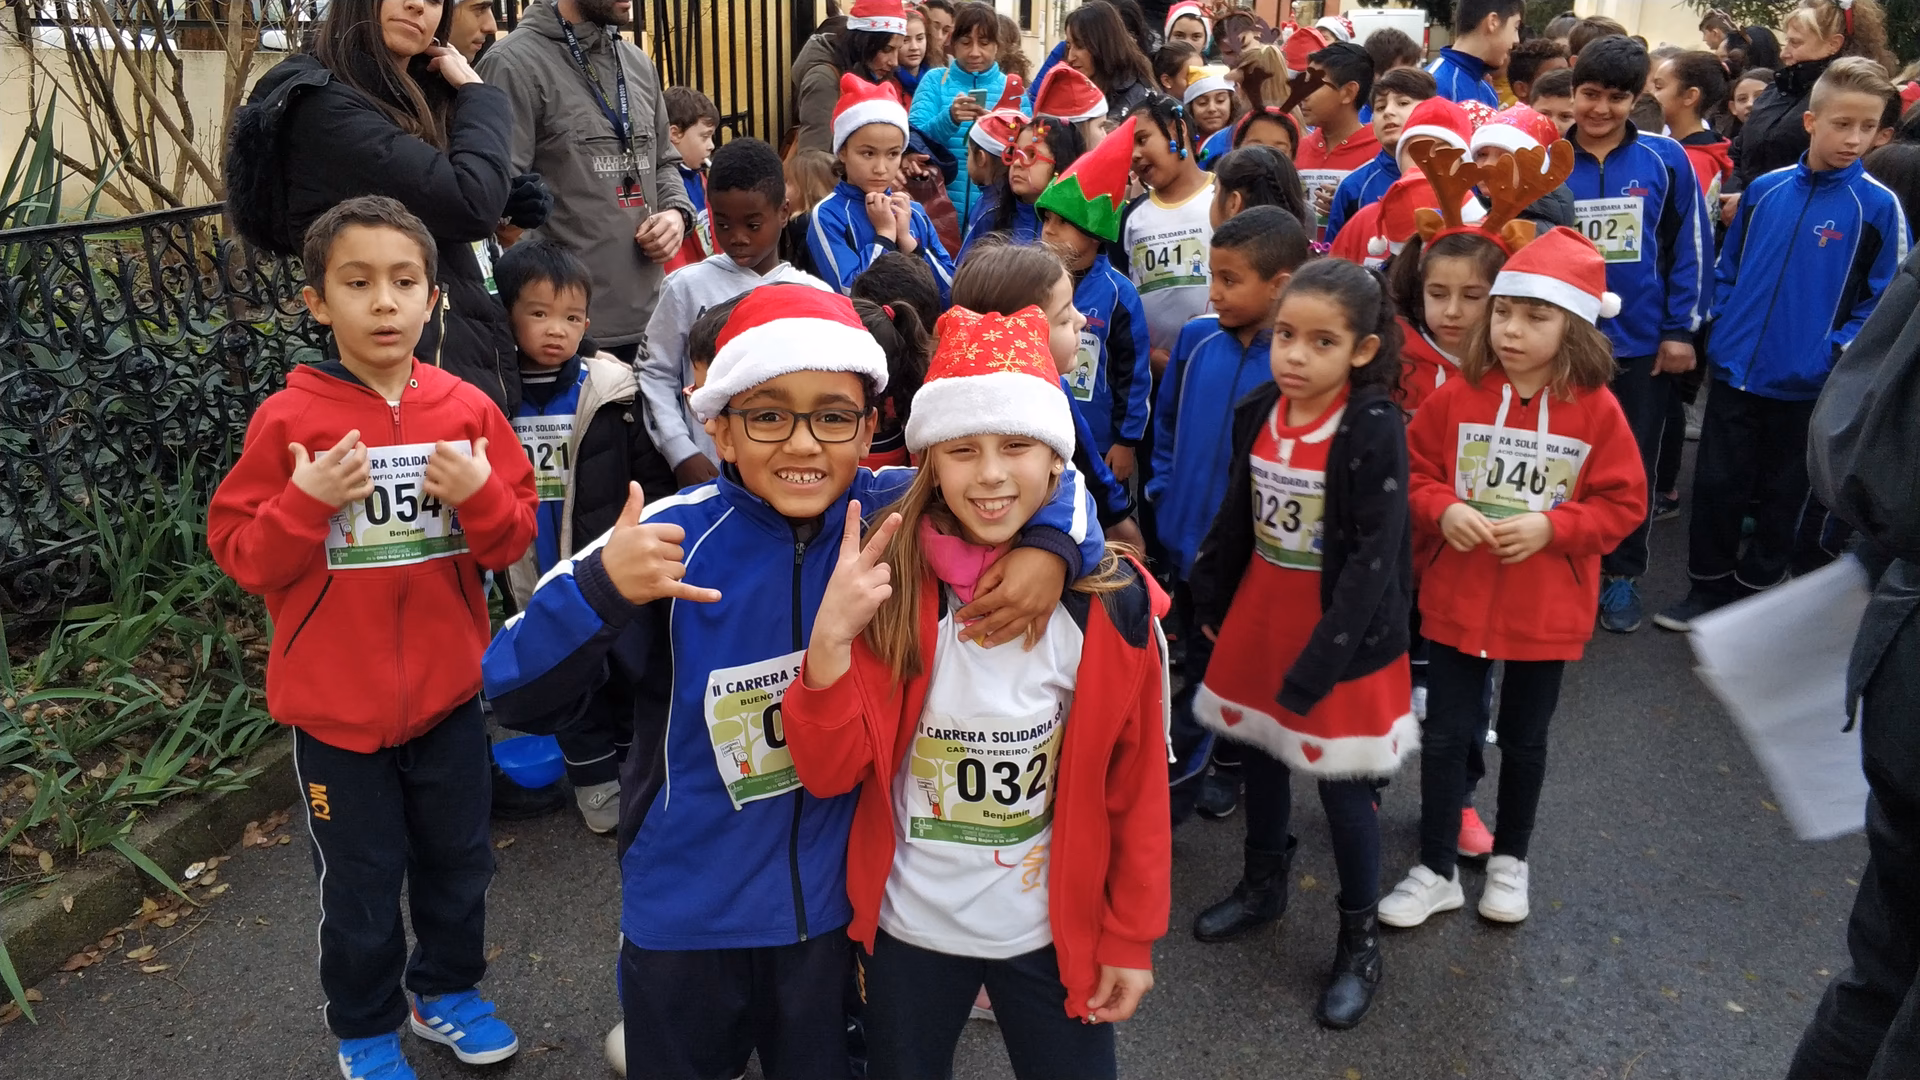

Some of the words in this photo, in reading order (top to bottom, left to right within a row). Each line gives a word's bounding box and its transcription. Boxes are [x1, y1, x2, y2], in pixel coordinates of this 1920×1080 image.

[620, 97, 628, 114] TOKYO
[1574, 218, 1618, 241] 102
[1145, 244, 1182, 272] 041
[1080, 338, 1095, 347] SMA
[535, 423, 573, 433] SOLIDARIA
[1473, 433, 1512, 446] CARRA
[1514, 439, 1560, 453] SOLIDRIA
[1561, 446, 1580, 458] SMA
[1486, 457, 1549, 495] 046
[365, 483, 442, 525] 054
[1251, 490, 1301, 533] 023
[712, 685, 721, 697] II
[726, 669, 789, 695] CARRERA
[740, 692, 774, 706] BUENO
[926, 726, 987, 743] CARRERA
[992, 719, 1053, 743] SOLIDARIA
[946, 746, 984, 756] CASTRO
[987, 748, 1030, 757] PEREIRO,
[957, 753, 1047, 805] 032
[982, 808, 1031, 822] Benjamín
